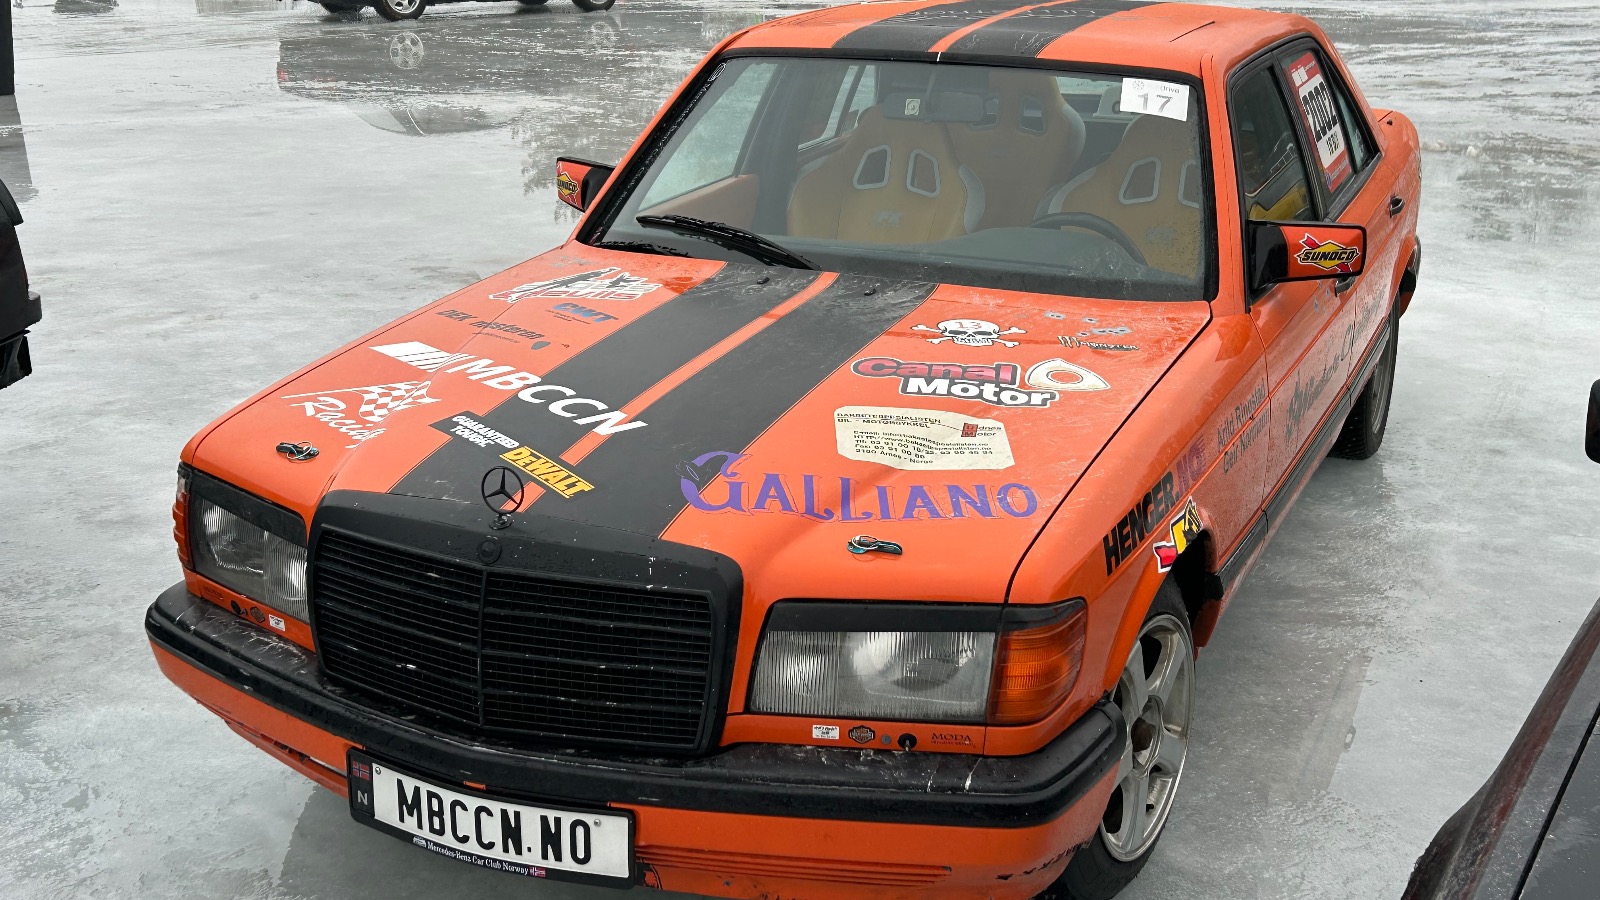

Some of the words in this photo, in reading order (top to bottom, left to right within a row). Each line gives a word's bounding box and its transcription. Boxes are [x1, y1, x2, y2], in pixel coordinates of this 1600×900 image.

[1137, 92, 1174, 114] 17
[1302, 81, 1338, 143] 2002
[1301, 250, 1357, 262] SUNOCO
[857, 357, 1013, 385] Canal
[467, 358, 648, 436] MBCCN
[907, 377, 1052, 406] Motor
[290, 397, 387, 449] Racing
[452, 415, 520, 449] GUARANTEED
[680, 451, 1041, 523] GALLIANO
[931, 733, 972, 741] MODA
[356, 790, 369, 806] N
[396, 778, 592, 865] MBCCN.NO
[427, 841, 472, 862] Mercedes-Benz
[472, 857, 484, 866] Car
[485, 859, 502, 868] Club
[502, 862, 529, 875] Norway
